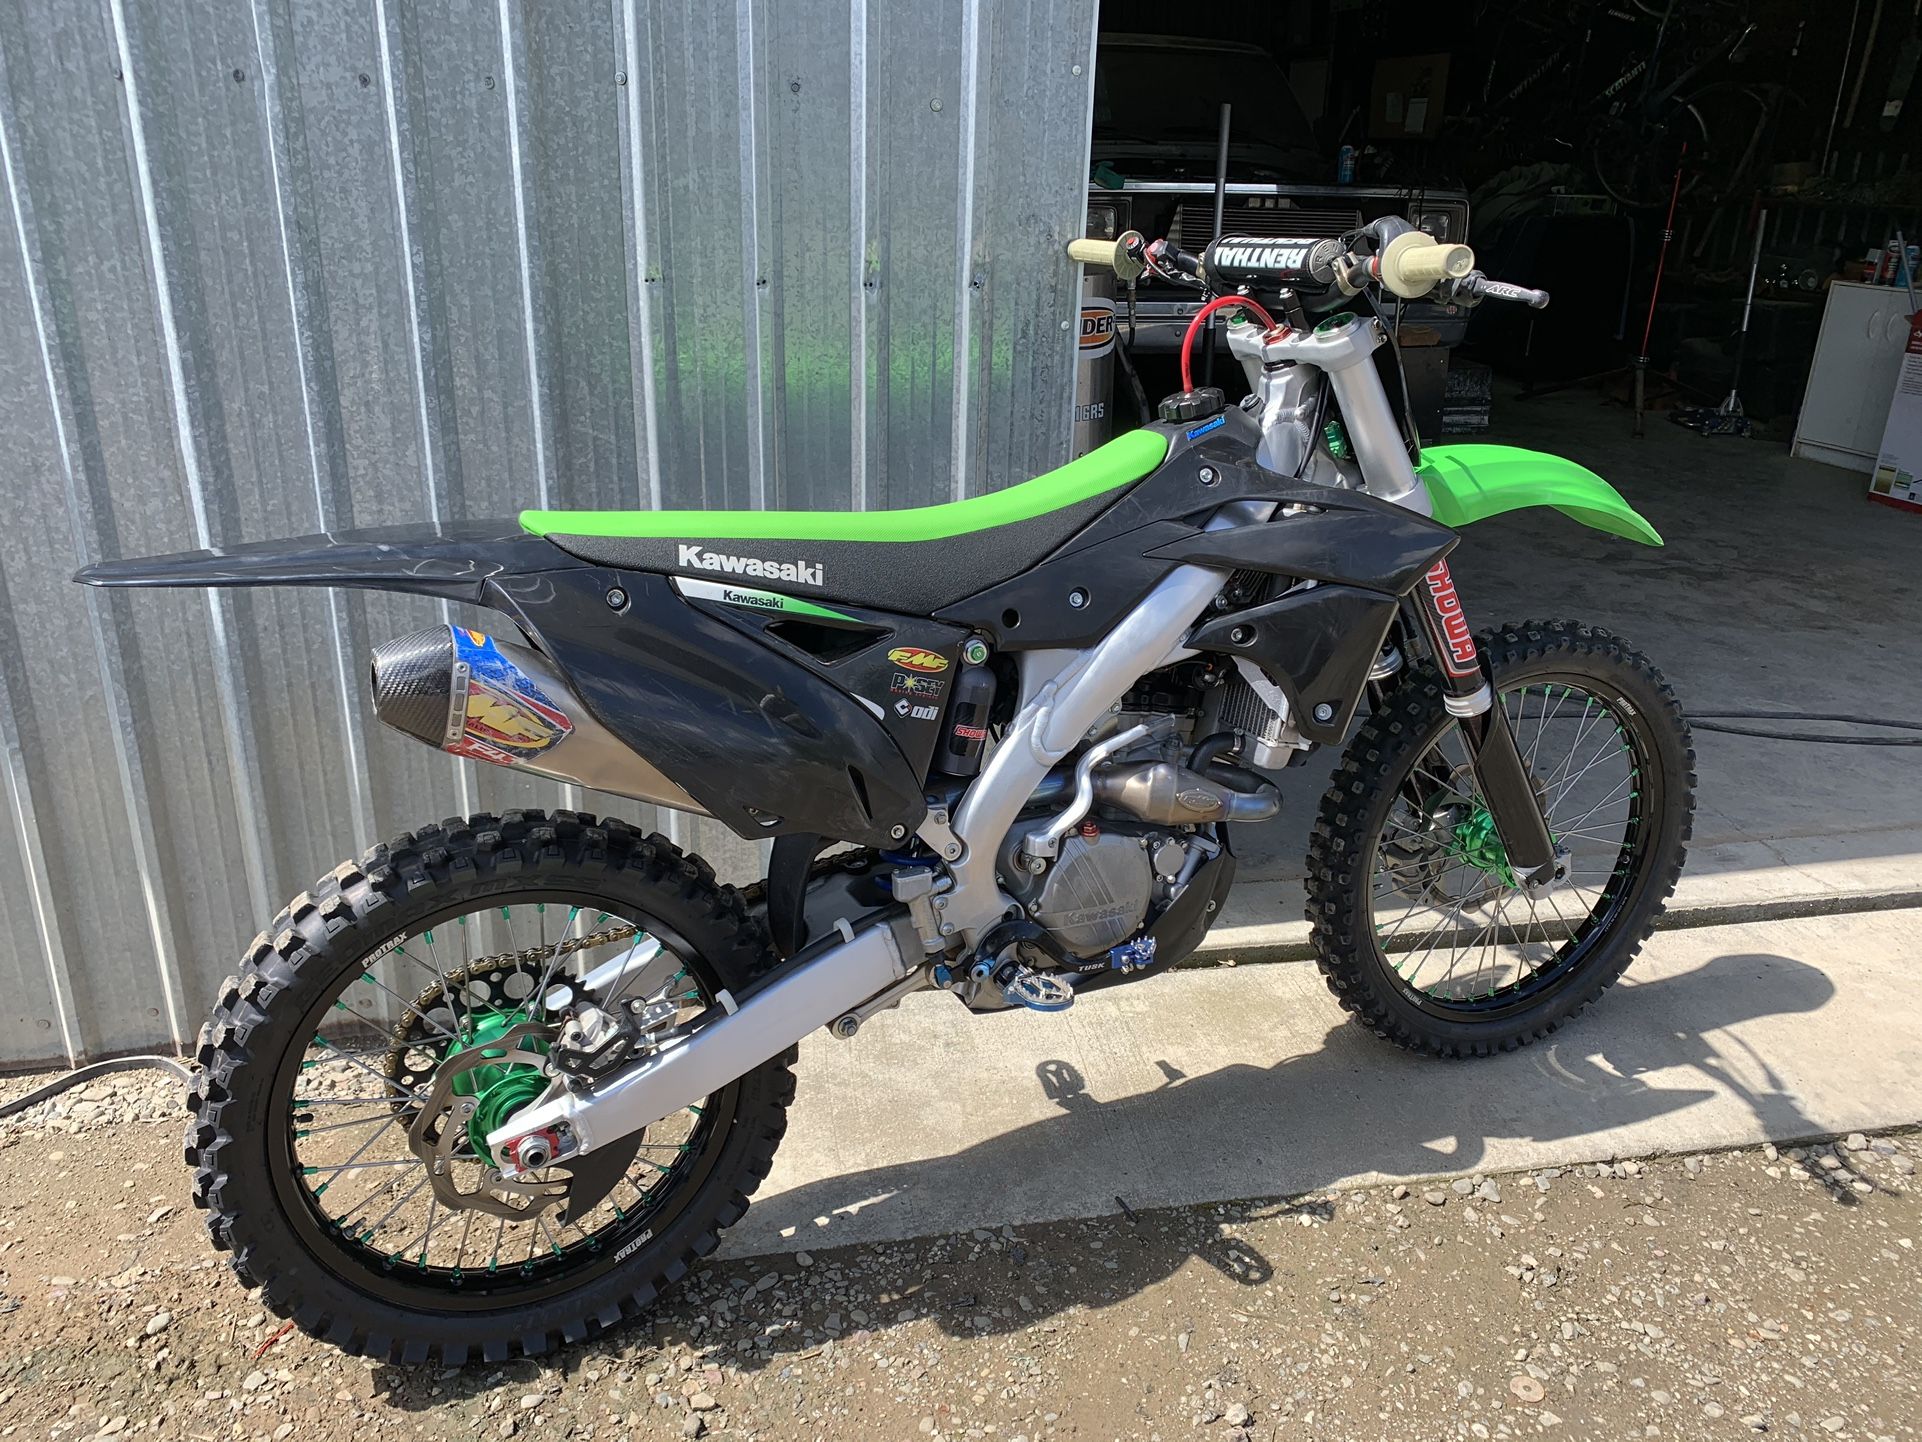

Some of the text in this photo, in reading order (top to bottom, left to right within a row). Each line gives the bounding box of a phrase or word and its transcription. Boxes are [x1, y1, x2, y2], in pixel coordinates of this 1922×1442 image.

[1486, 285, 1521, 298] ARC
[1080, 316, 1114, 336] DER
[1186, 414, 1226, 441] Kawasaki
[678, 544, 823, 586] Kawasaki
[723, 589, 784, 609] Kawasaki
[888, 649, 949, 669] FMF
[1063, 900, 1138, 926] Kawasaki
[361, 931, 407, 968] PROTRAX
[1078, 962, 1105, 972] TUSK
[613, 1229, 653, 1264] PROTRAX
